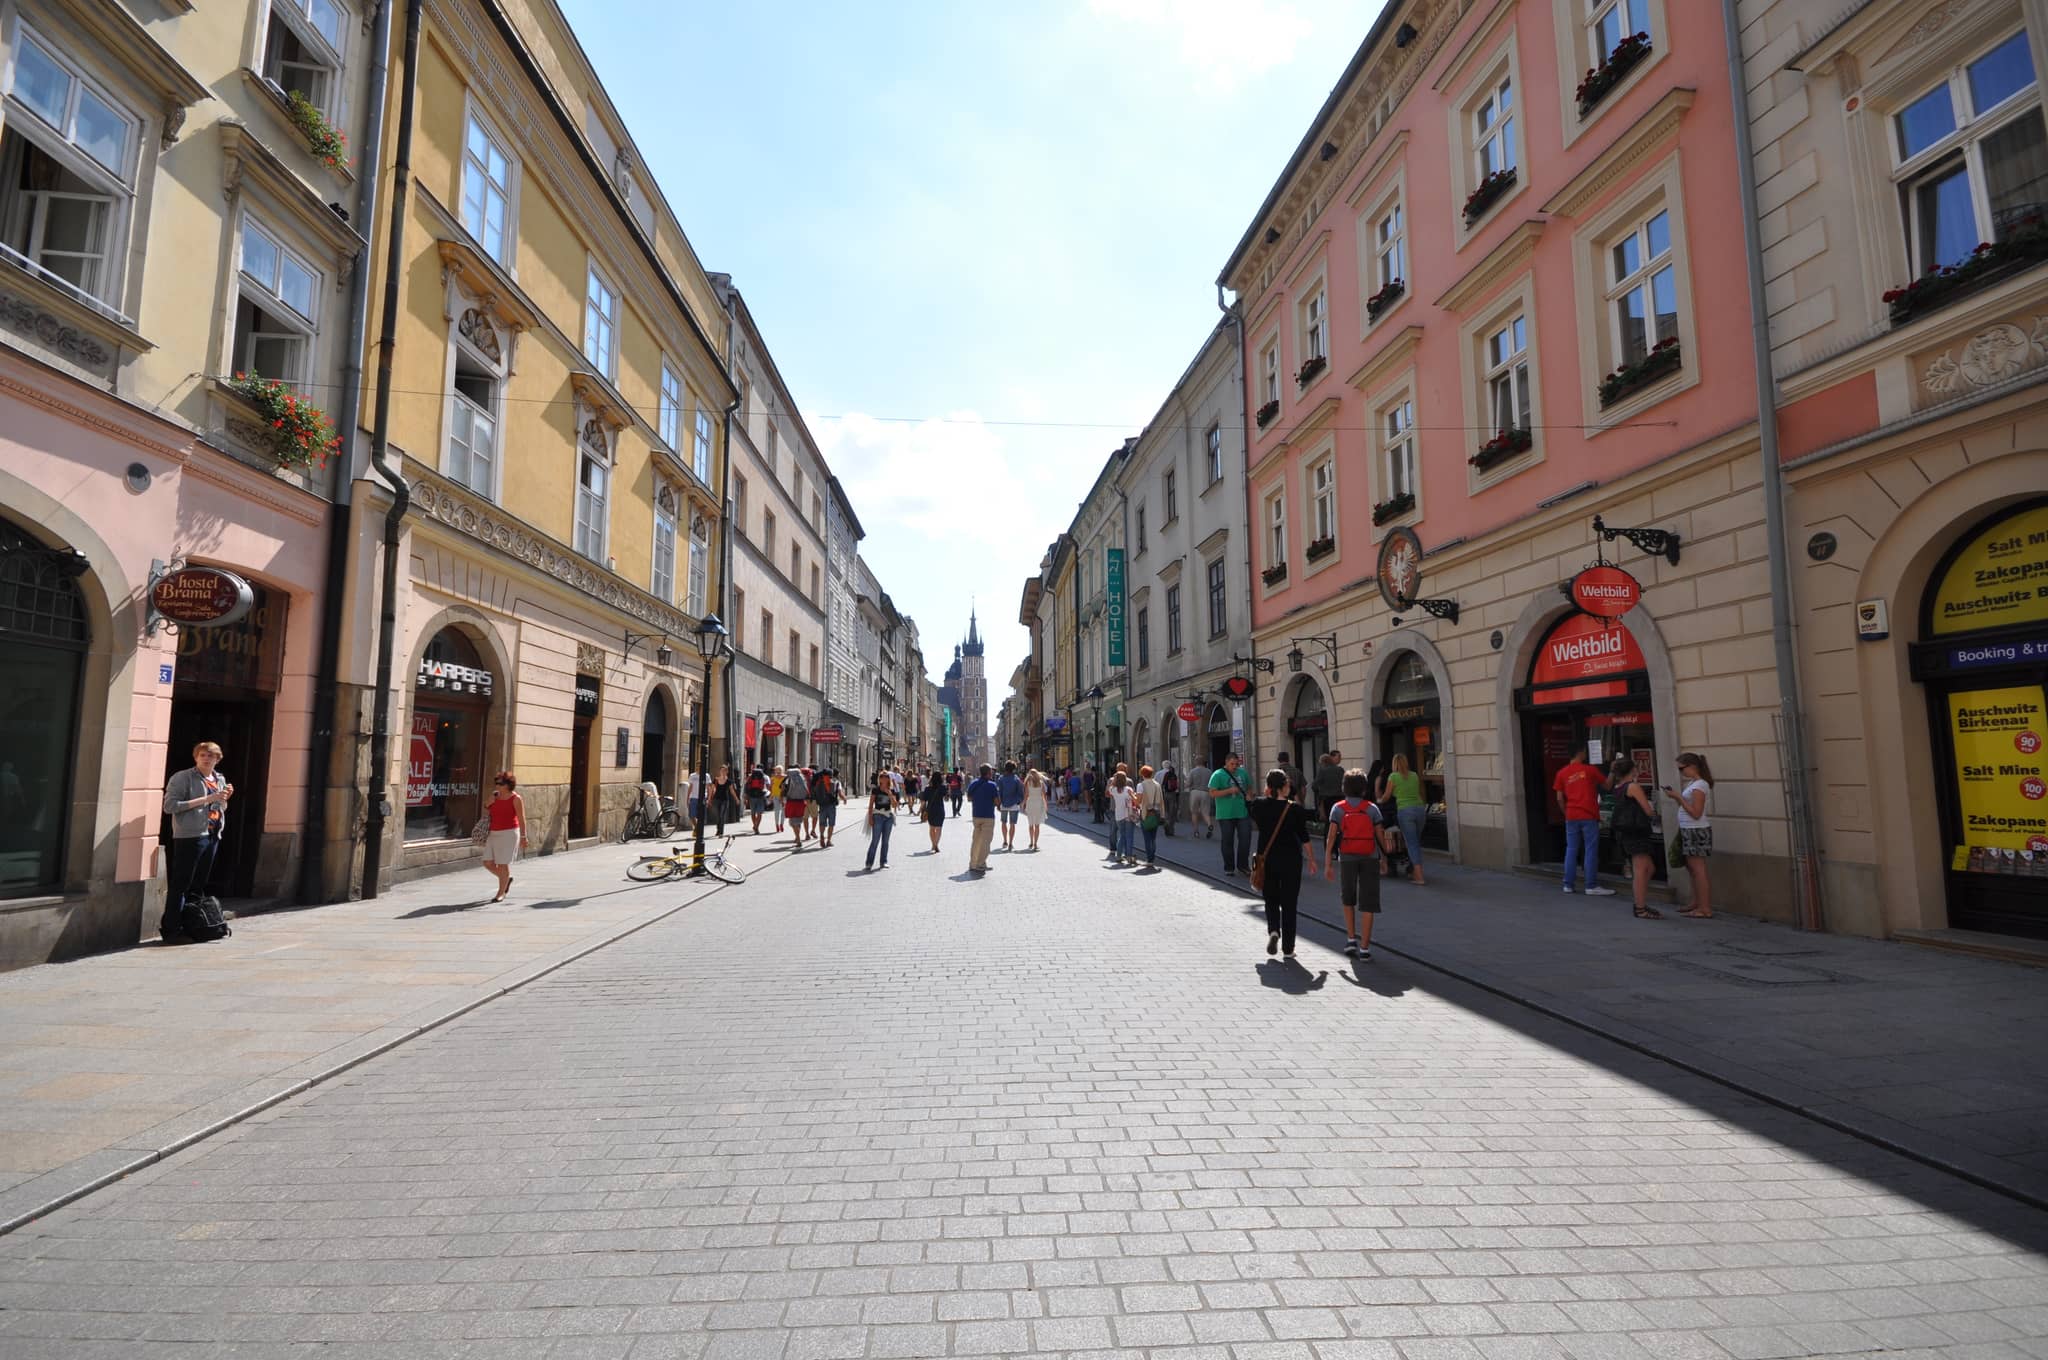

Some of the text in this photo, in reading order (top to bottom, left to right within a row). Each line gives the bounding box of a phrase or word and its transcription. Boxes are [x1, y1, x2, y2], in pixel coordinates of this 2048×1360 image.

[1987, 537, 2023, 554] Salt
[178, 574, 220, 590] hostel
[156, 583, 212, 600] Brama
[1581, 584, 1630, 598] Weltbild
[1944, 590, 2032, 614] Auschwitz
[1110, 592, 1120, 654] HOTEL
[1552, 630, 1622, 662] Weltbild
[1958, 647, 2016, 662] Booking
[2022, 642, 2034, 655] &
[419, 658, 492, 686] HARPERS
[418, 676, 492, 696] SHOES
[1384, 704, 1425, 719] NUGGET
[1958, 704, 2038, 718] Auschwitz
[1958, 716, 2029, 728] Birkenau
[2020, 736, 2036, 747] 90
[408, 761, 432, 778] ALE
[1963, 764, 2040, 776] Salt Mine
[2024, 784, 2042, 794] 100
[1968, 814, 2047, 828] Zakopane
